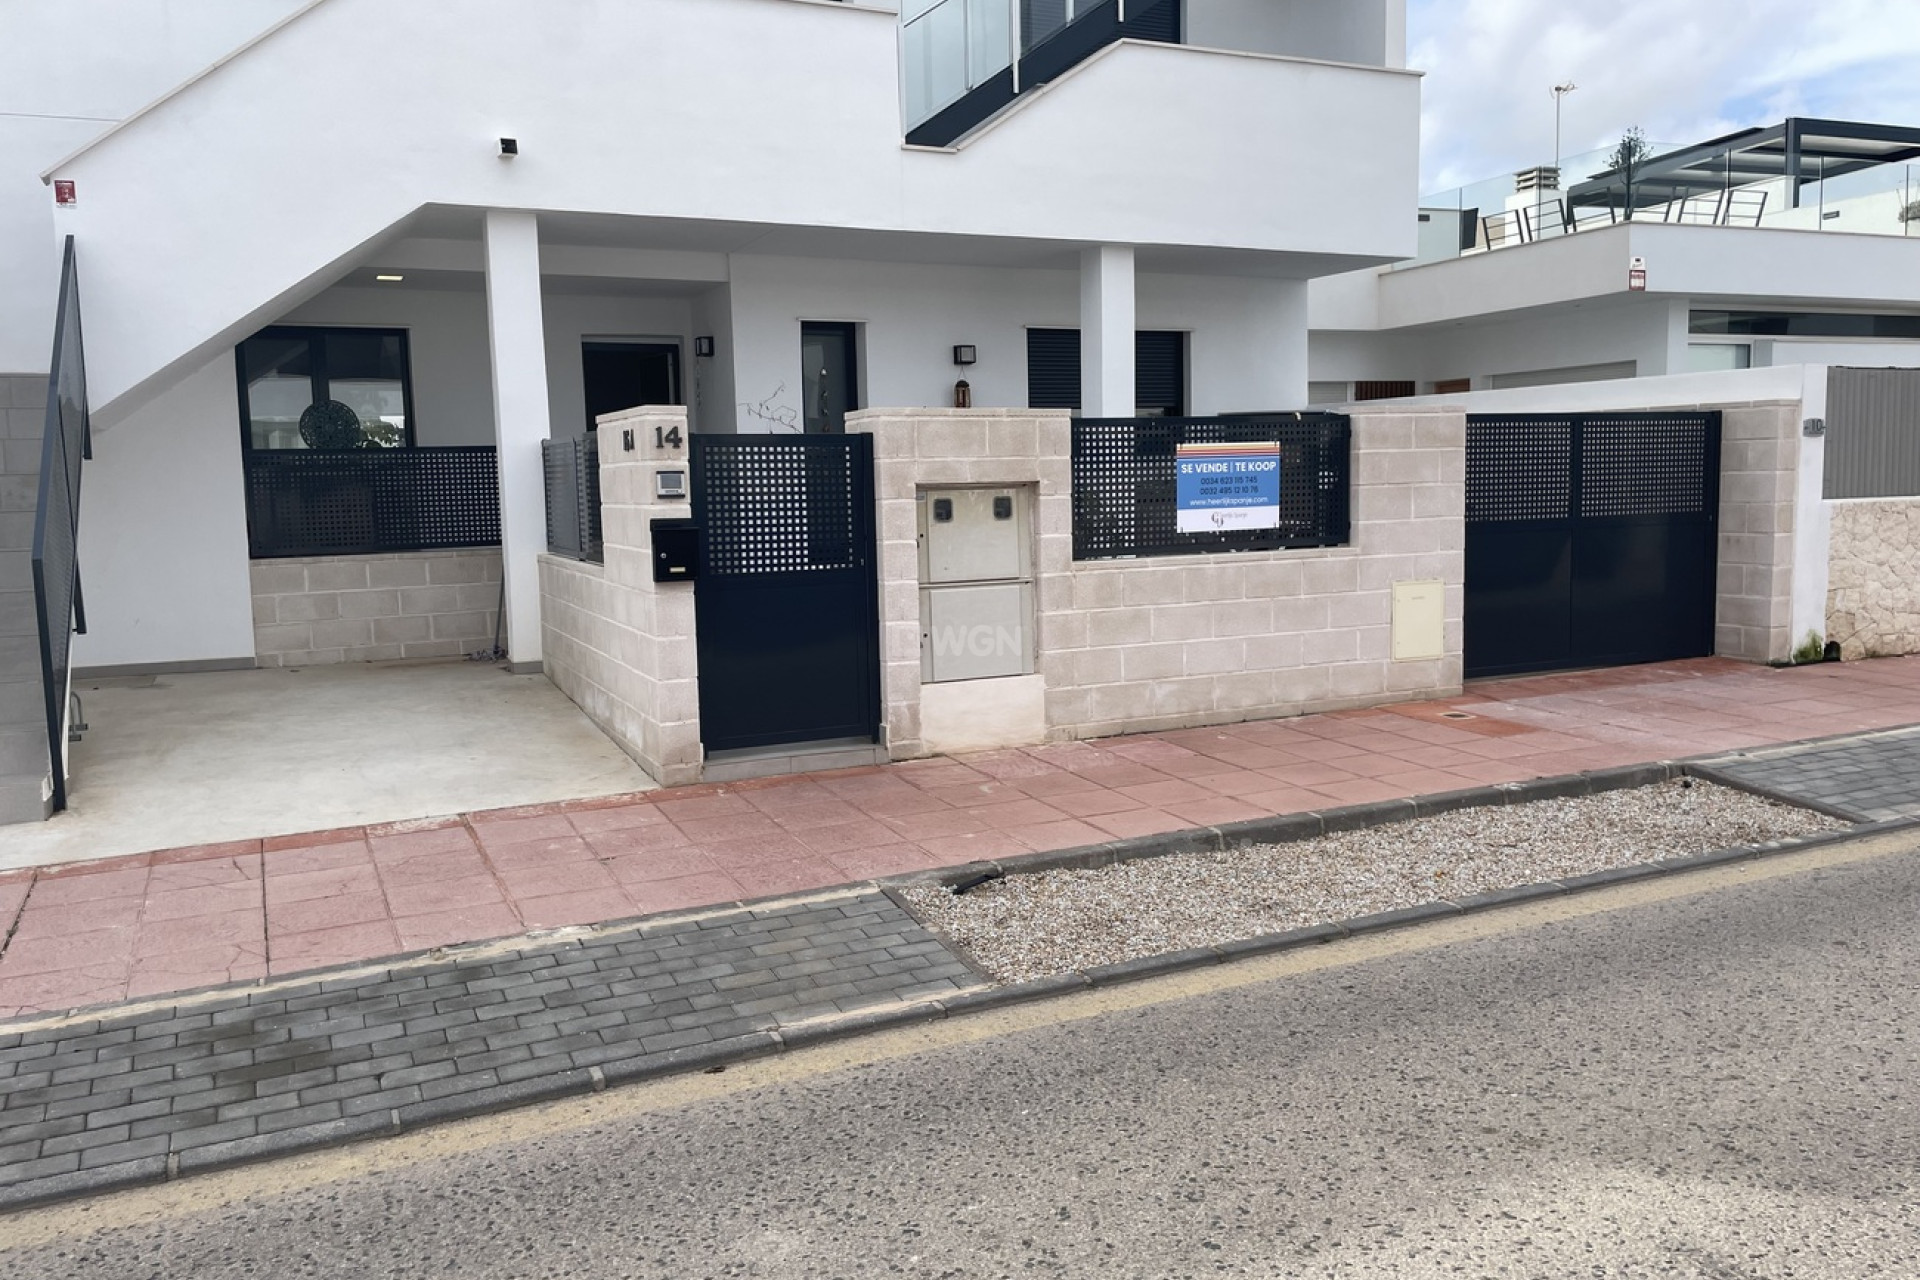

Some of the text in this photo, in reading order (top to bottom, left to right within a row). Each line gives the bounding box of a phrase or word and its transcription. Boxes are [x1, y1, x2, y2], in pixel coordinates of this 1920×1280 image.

[655, 425, 682, 449] 14
[1181, 462, 1276, 473] SE VENDE TE KOOP
[1201, 477, 1219, 485] 0034
[1200, 487, 1218, 495] 0032
